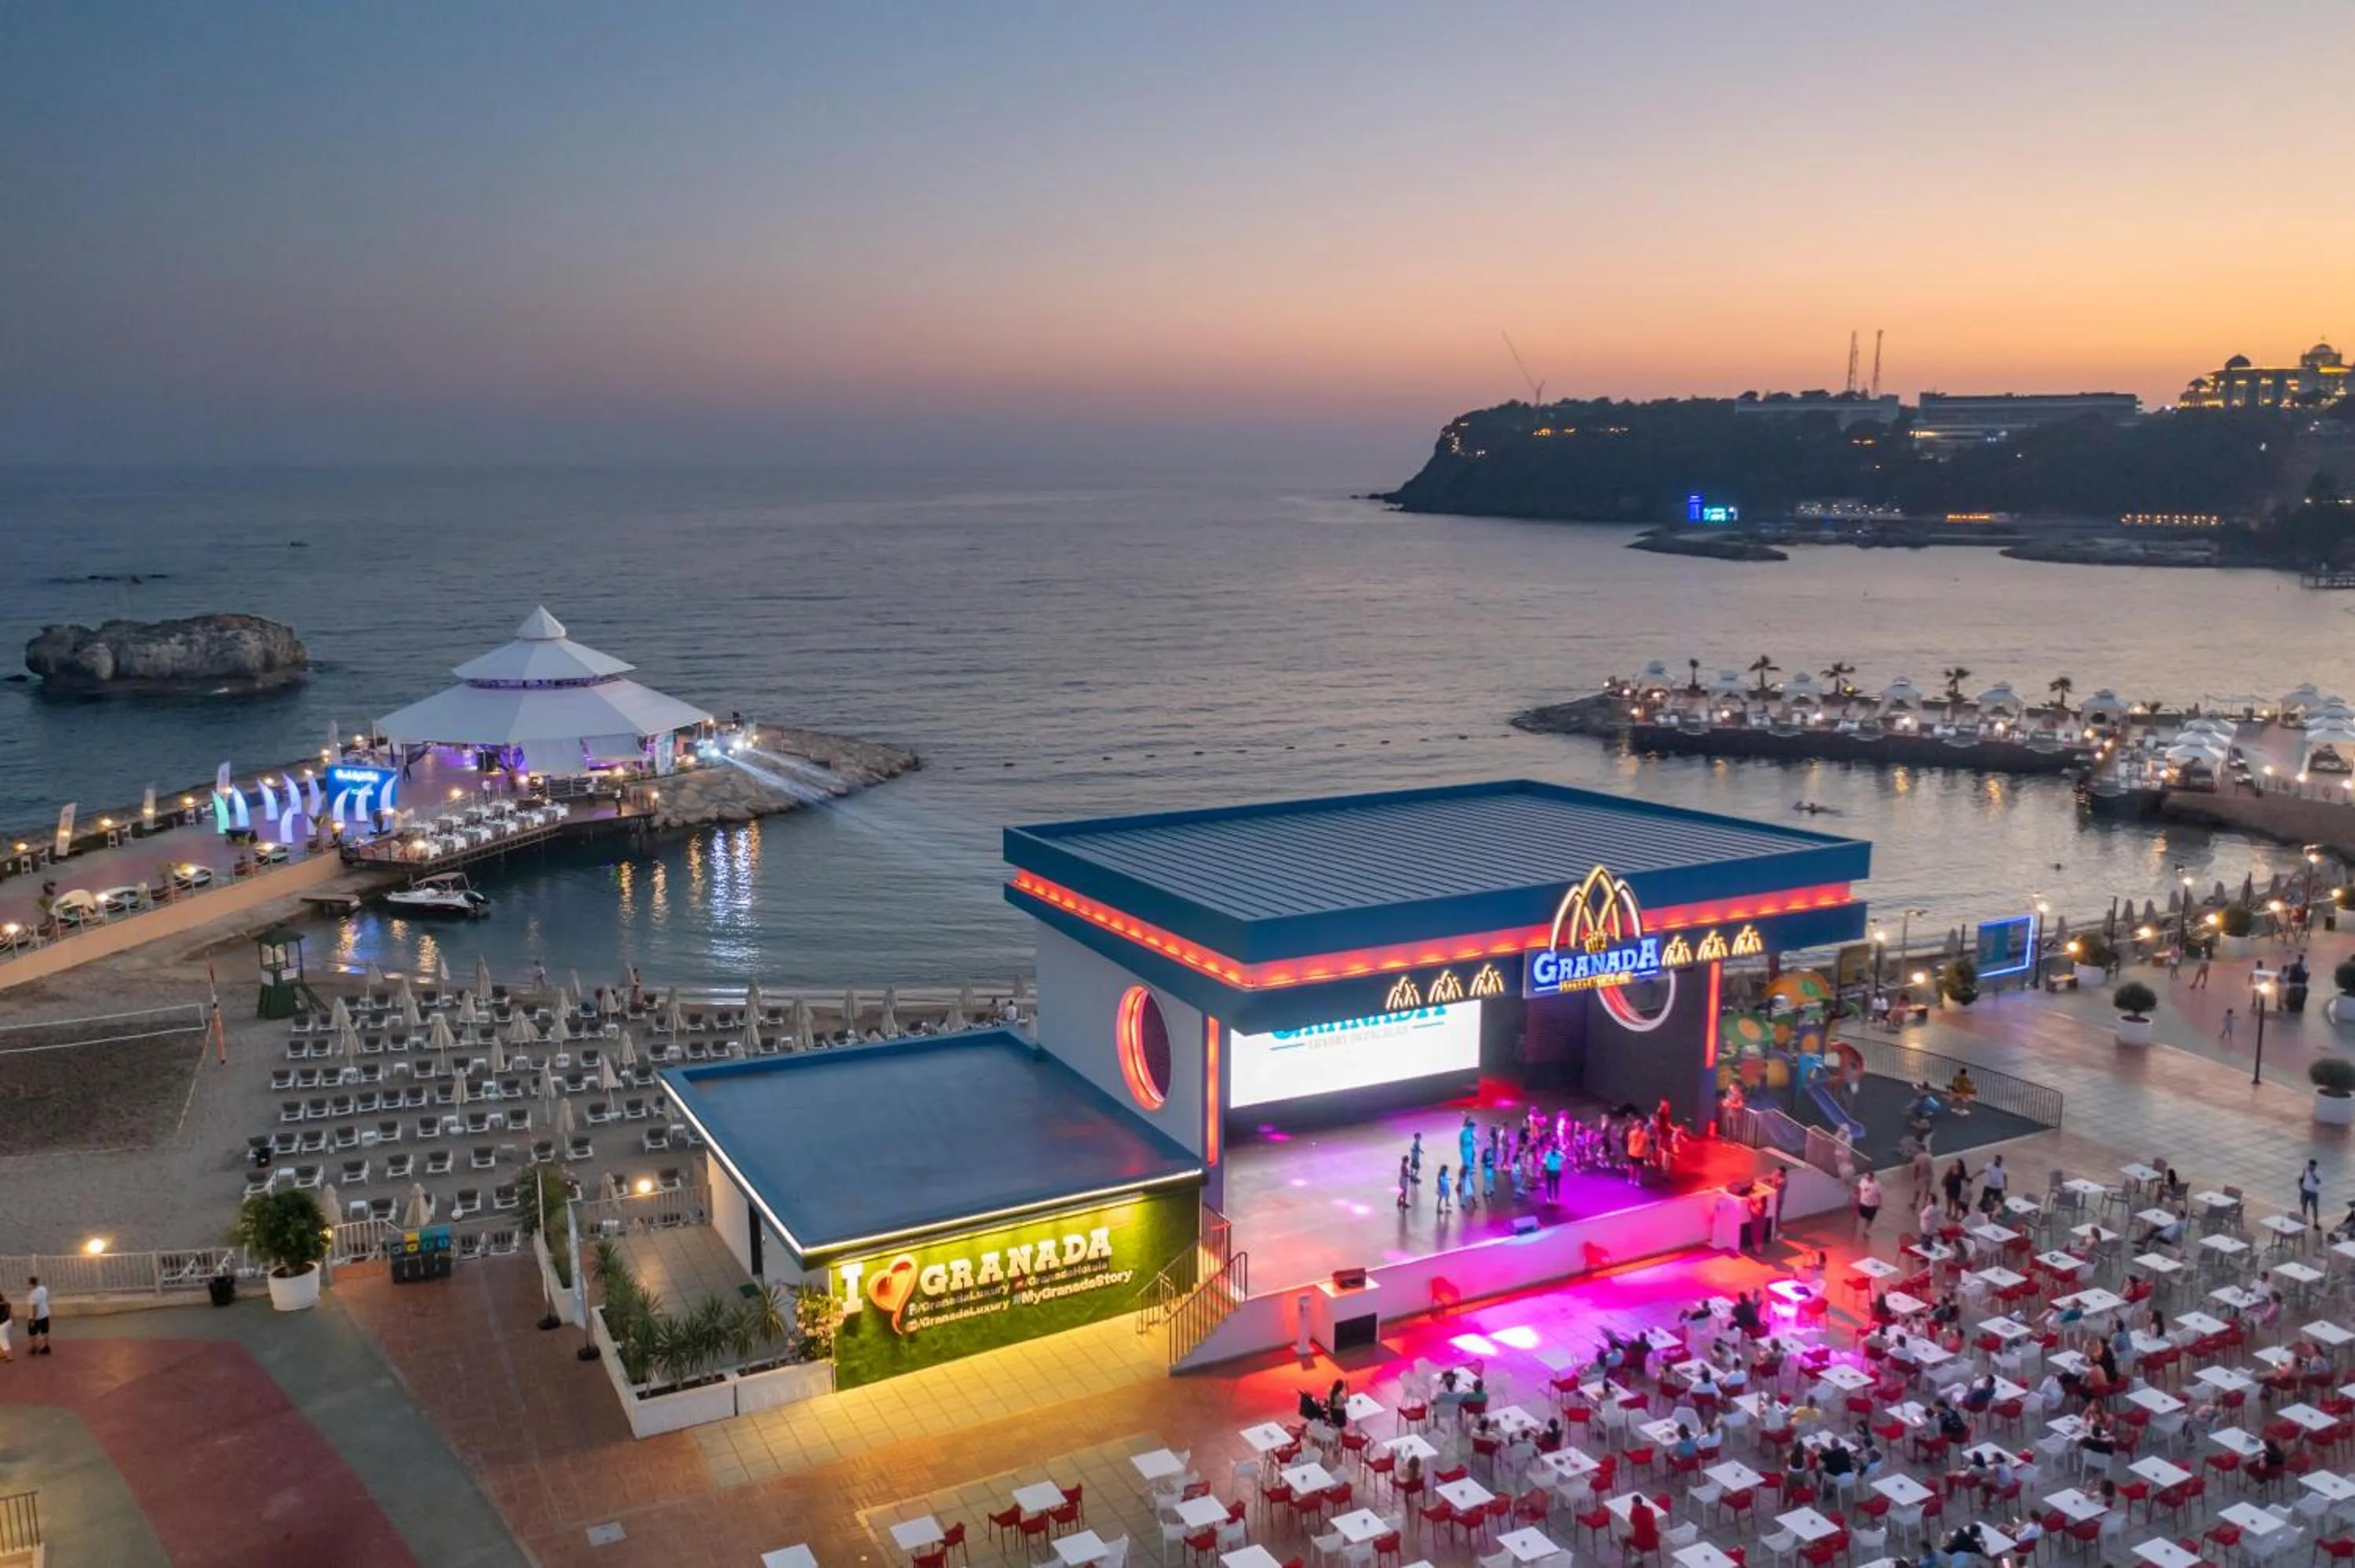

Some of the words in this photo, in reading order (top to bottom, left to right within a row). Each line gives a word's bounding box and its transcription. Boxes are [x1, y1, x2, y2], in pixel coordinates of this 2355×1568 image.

[1533, 938, 1659, 984] GRANADA
[841, 1262, 863, 1314] I
[920, 1227, 1112, 1296] GRANADA
